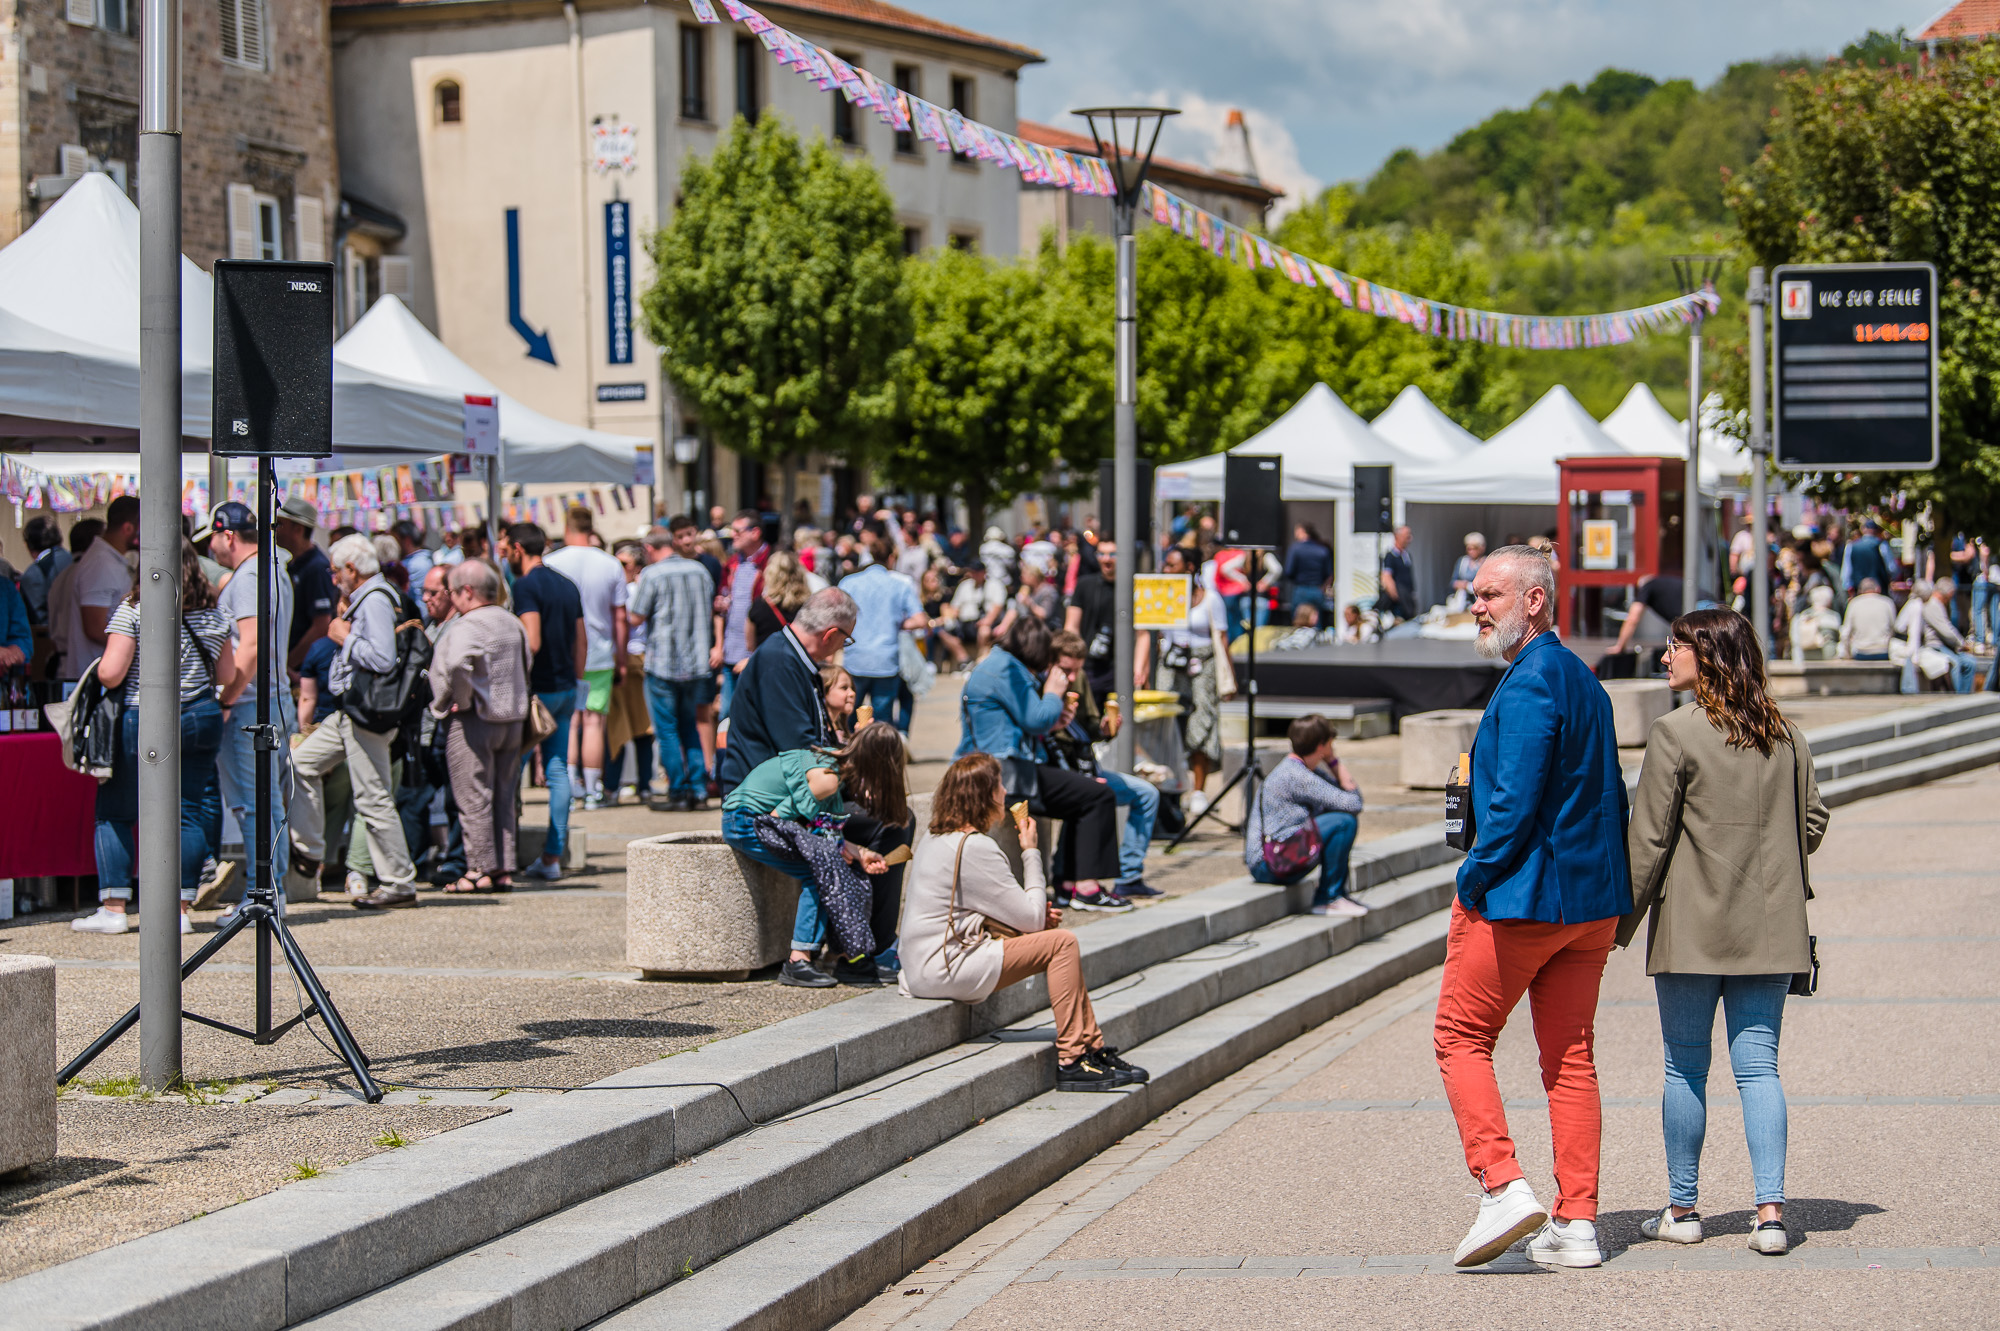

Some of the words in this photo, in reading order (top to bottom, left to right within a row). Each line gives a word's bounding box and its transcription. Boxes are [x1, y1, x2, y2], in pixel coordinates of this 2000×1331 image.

[291, 281, 317, 291] NEXO
[1819, 289, 1843, 307] VIC
[1846, 289, 1875, 307] SUR
[1877, 287, 1923, 307] SEILLE
[232, 420, 249, 436] PS
